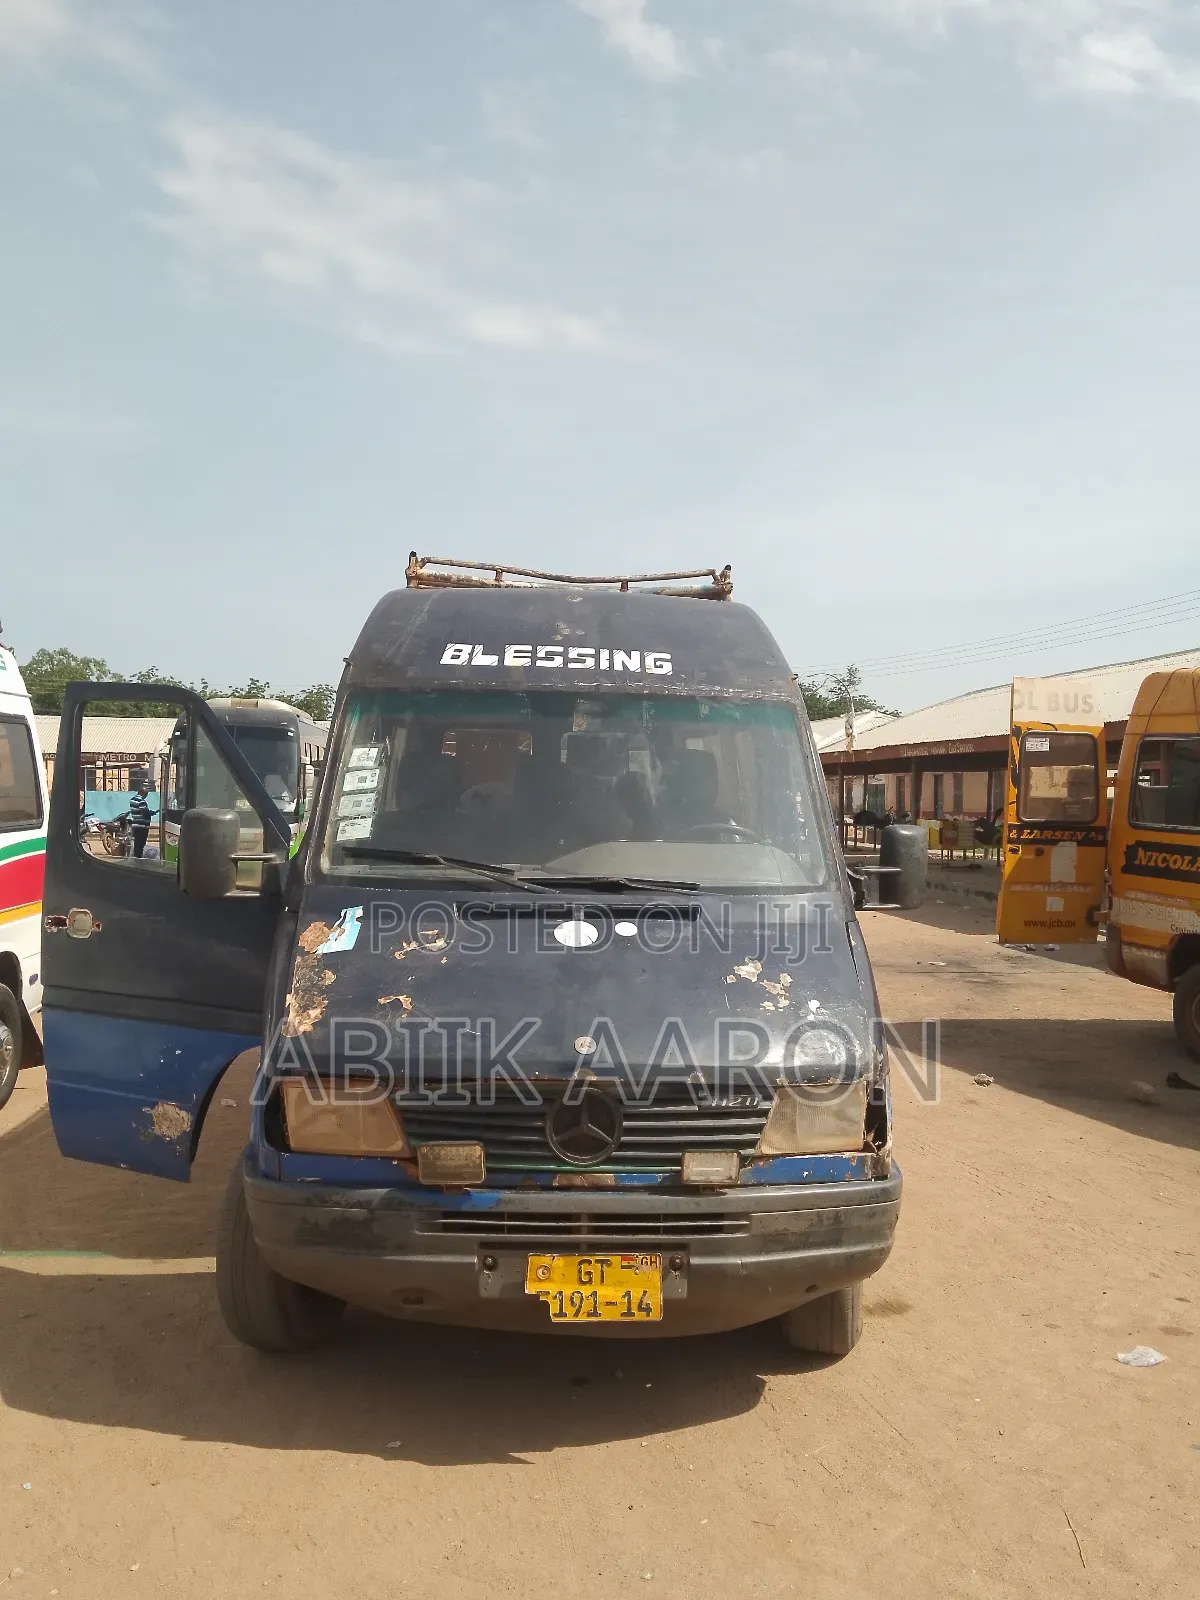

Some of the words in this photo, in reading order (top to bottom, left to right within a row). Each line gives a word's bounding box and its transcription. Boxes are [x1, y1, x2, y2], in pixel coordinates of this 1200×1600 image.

[439, 643, 673, 675] BLESSING
[1047, 691, 1094, 714] BUS
[101, 753, 137, 761] METRO
[1009, 829, 1018, 838] &
[1020, 829, 1087, 840] LARSEN
[1024, 918, 1077, 929] www.jcb.dk
[576, 1258, 611, 1286] GT
[641, 1256, 658, 1268] GH
[536, 1290, 653, 1318] 191-14
